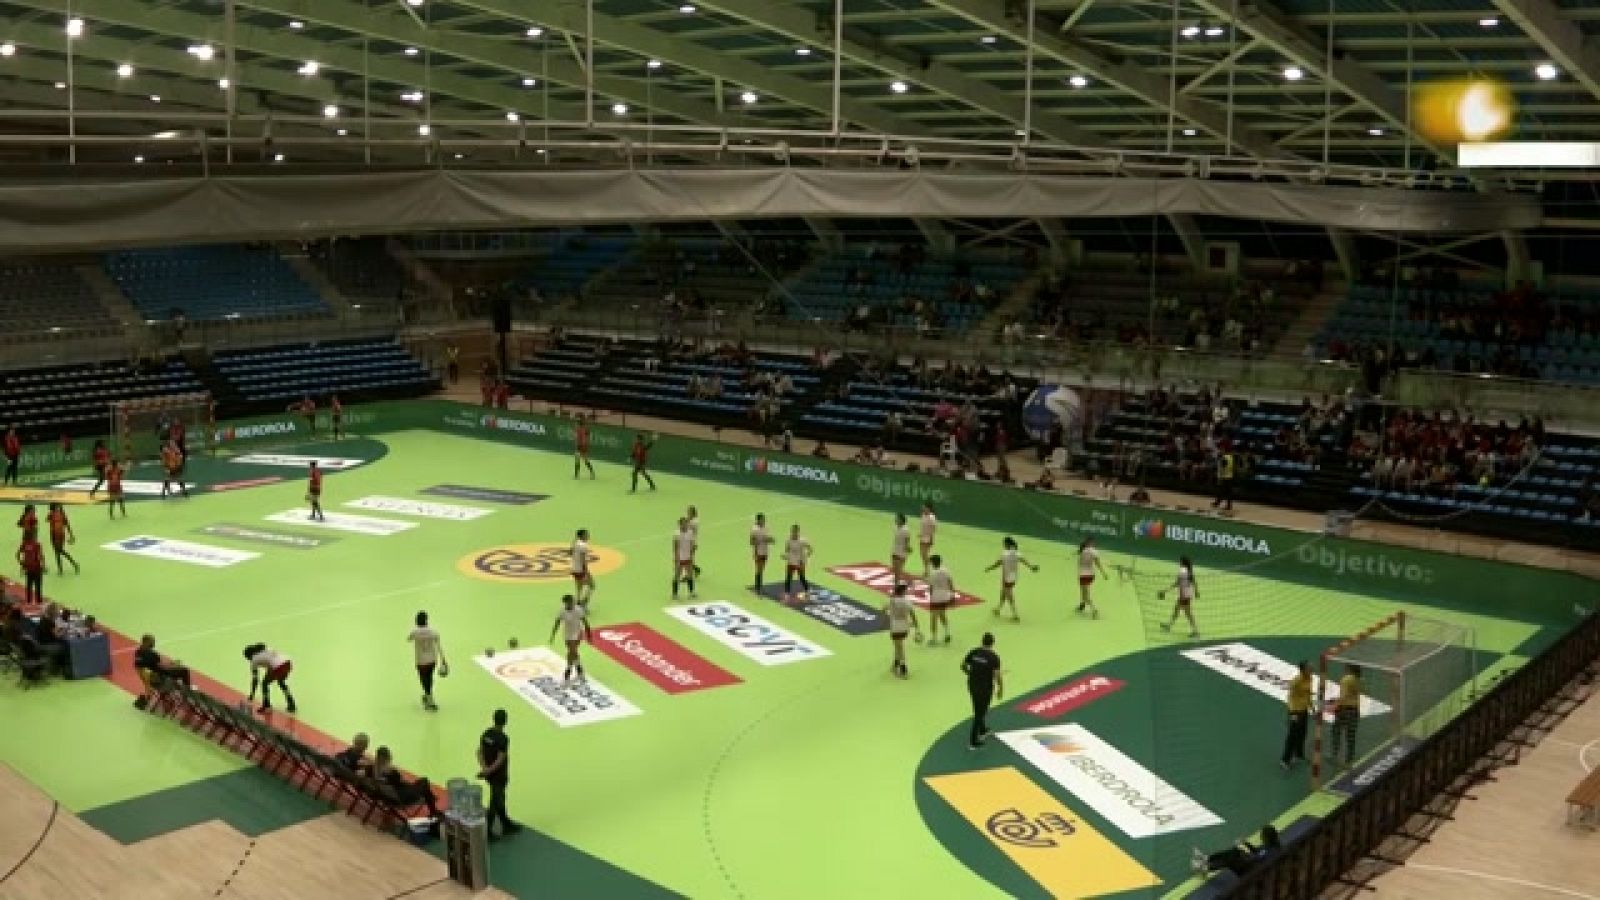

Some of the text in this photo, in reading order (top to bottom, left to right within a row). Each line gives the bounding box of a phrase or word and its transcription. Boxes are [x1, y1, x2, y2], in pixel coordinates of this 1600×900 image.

[767, 461, 841, 486] IBERDROLA
[1164, 523, 1271, 556] IBERDROLA
[1066, 756, 1176, 827] IBERDROLA
